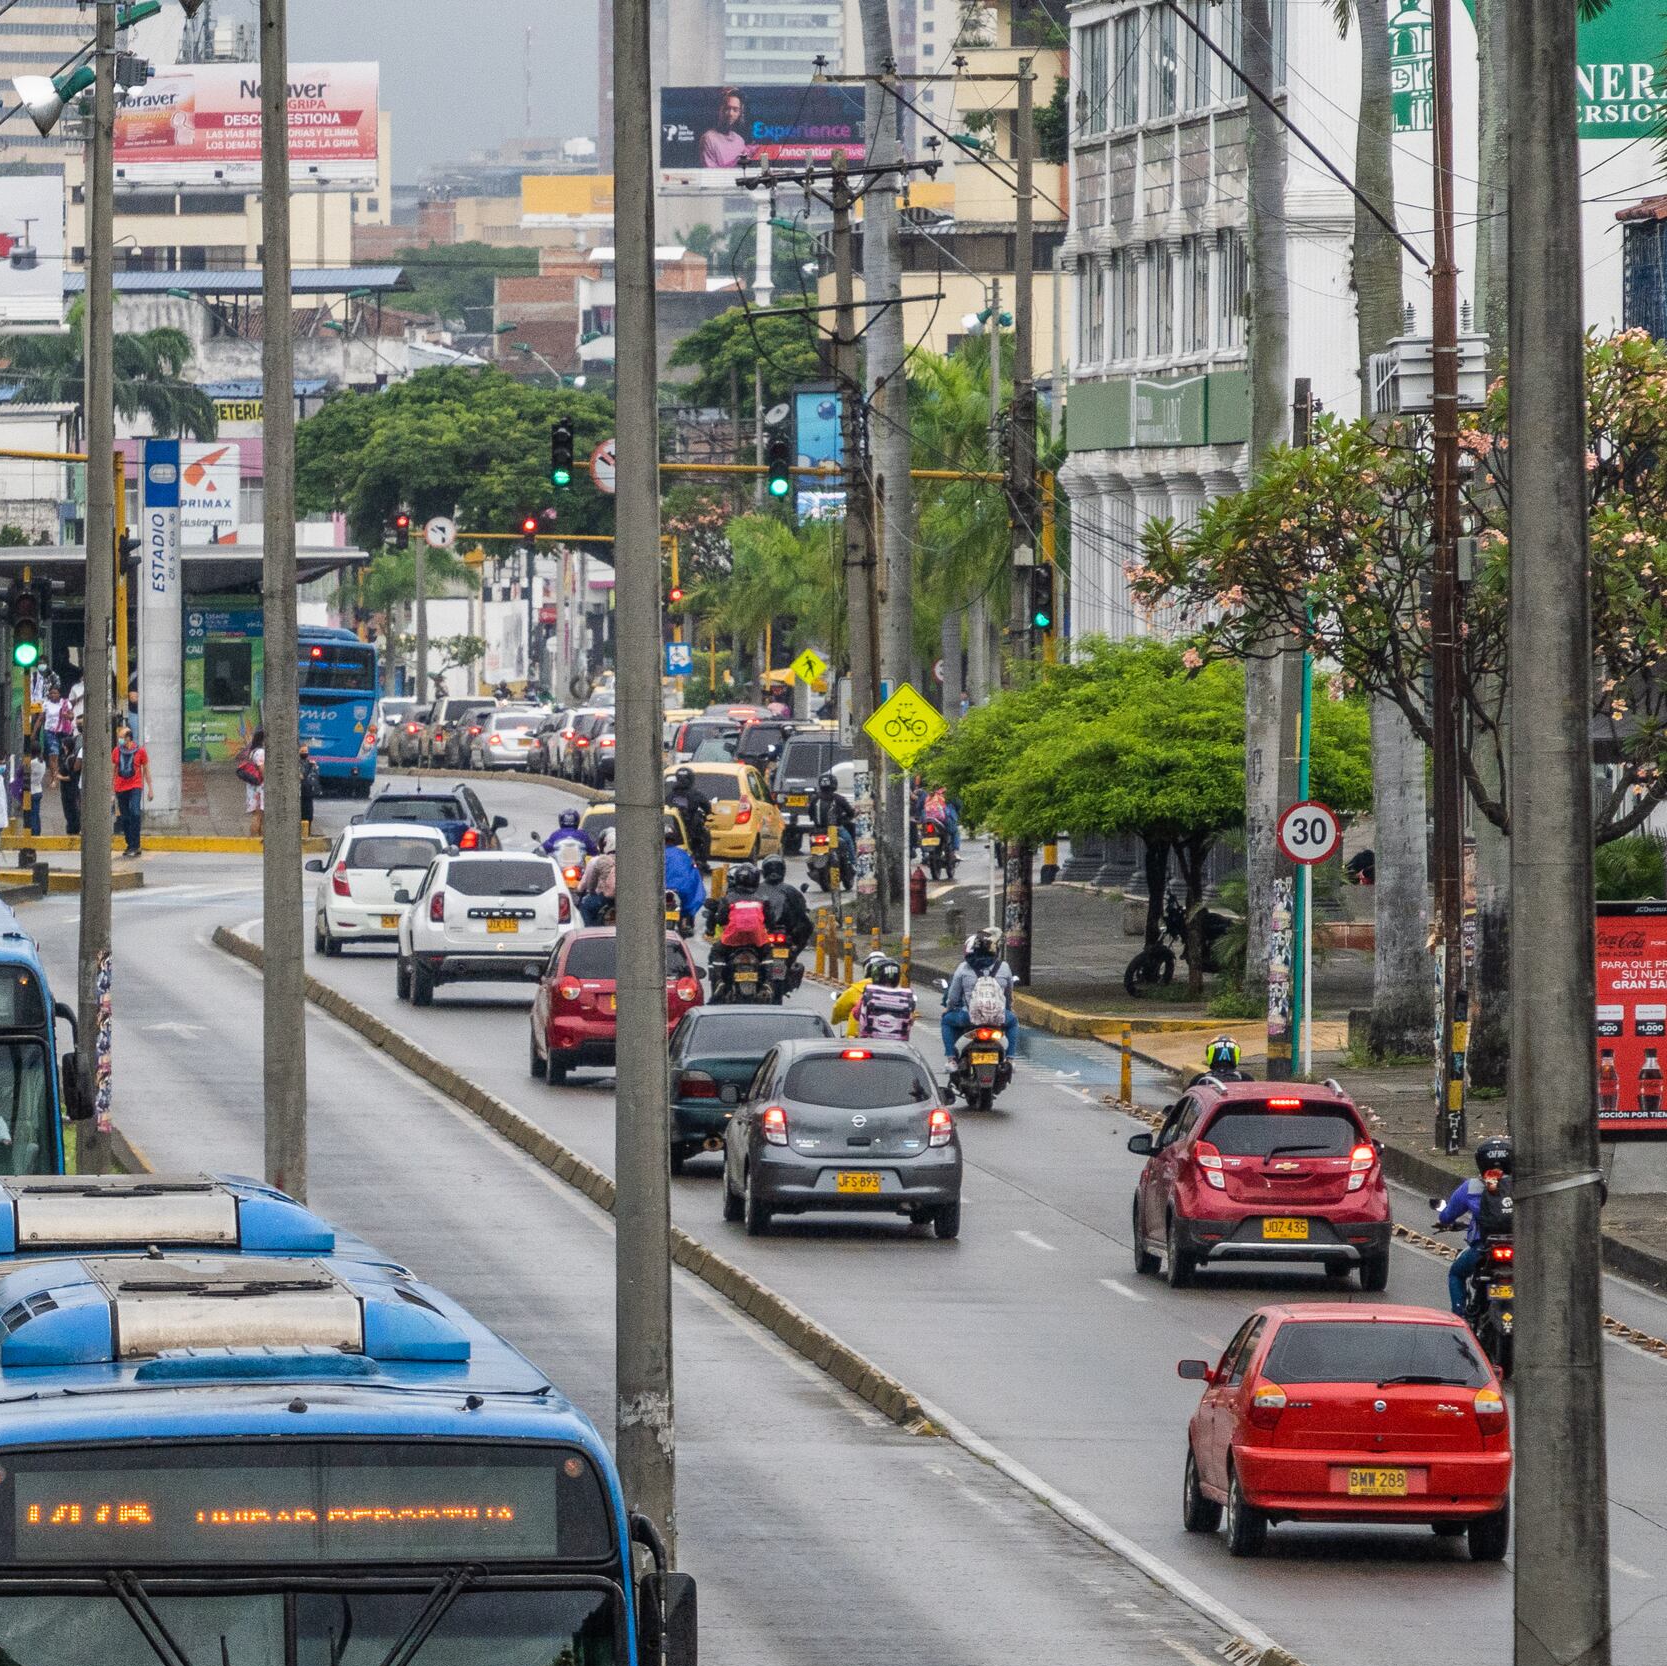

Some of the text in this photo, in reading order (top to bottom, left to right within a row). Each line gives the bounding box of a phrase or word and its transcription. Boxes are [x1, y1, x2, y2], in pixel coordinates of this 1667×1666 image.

[288, 100, 327, 109] GRIPA
[753, 121, 851, 141] Experience
[180, 499, 231, 508] PRIMAX
[151, 513, 165, 593] ESTADIO
[1292, 818, 1327, 846] 30
[1601, 960, 1629, 969] PARA
[1631, 960, 1653, 969] QUE
[1622, 969, 1667, 979] SU NUE
[1612, 979, 1667, 989] GRAN SA
[1598, 1110, 1630, 1118] MOCIÓN
[839, 1175, 879, 1188] JFS 893
[1287, 1221, 1308, 1233] 435
